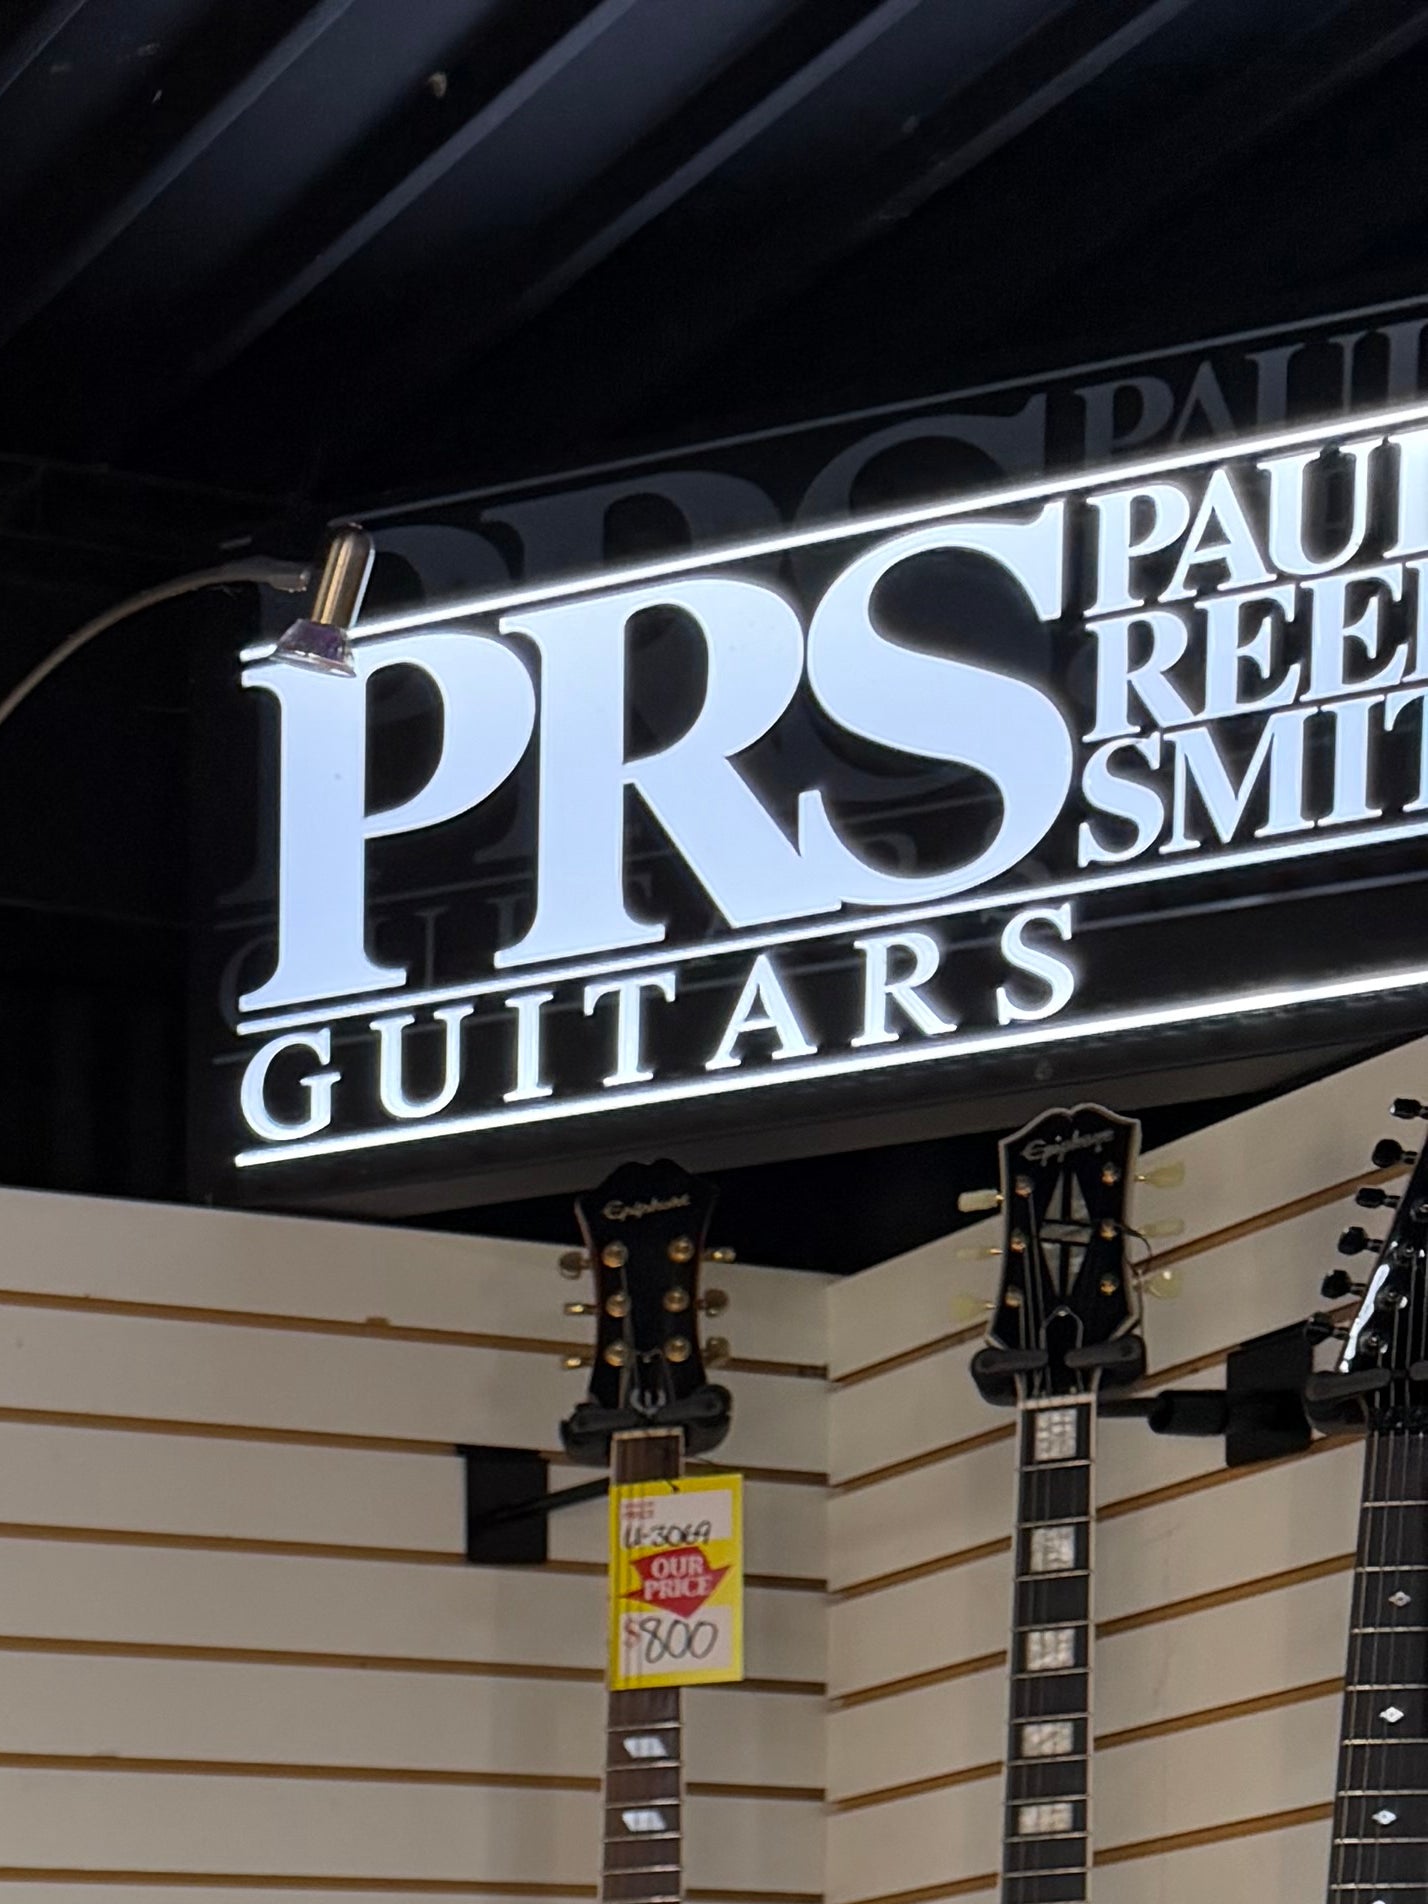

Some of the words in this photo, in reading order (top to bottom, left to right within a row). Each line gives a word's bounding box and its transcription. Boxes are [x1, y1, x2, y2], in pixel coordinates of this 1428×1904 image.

[1082, 558, 1428, 742] REE
[239, 501, 1072, 1009] PRS
[239, 900, 1078, 1141] GUITARS
[644, 1575, 713, 1601] PRICE
[650, 1554, 705, 1579] OUR
[623, 1617, 719, 1664] $800
